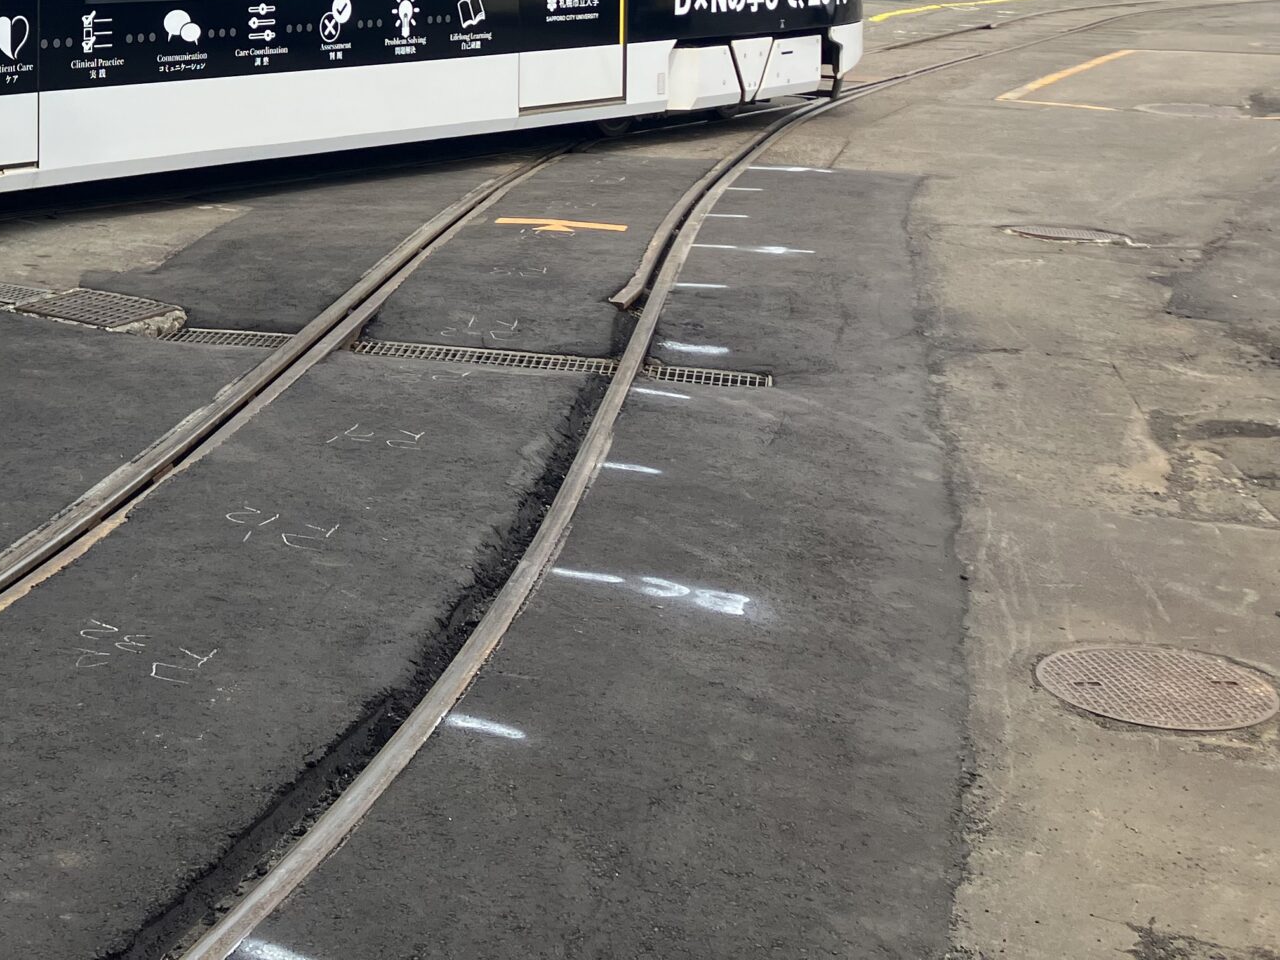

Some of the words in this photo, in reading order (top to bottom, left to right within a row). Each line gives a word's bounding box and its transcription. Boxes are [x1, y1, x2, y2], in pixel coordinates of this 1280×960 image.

[320, 42, 352, 50] Assessment
[384, 38, 407, 46] Problem
[407, 36, 427, 45] Solving
[235, 48, 249, 57] Care
[249, 46, 288, 56] Coordination
[157, 52, 208, 63] Communication
[16, 63, 34, 72] Care
[70, 58, 97, 69] Clinical
[97, 57, 125, 68] Practice
[158, 62, 206, 72] コミュニケーション
[5, 75, 19, 84] ケア
